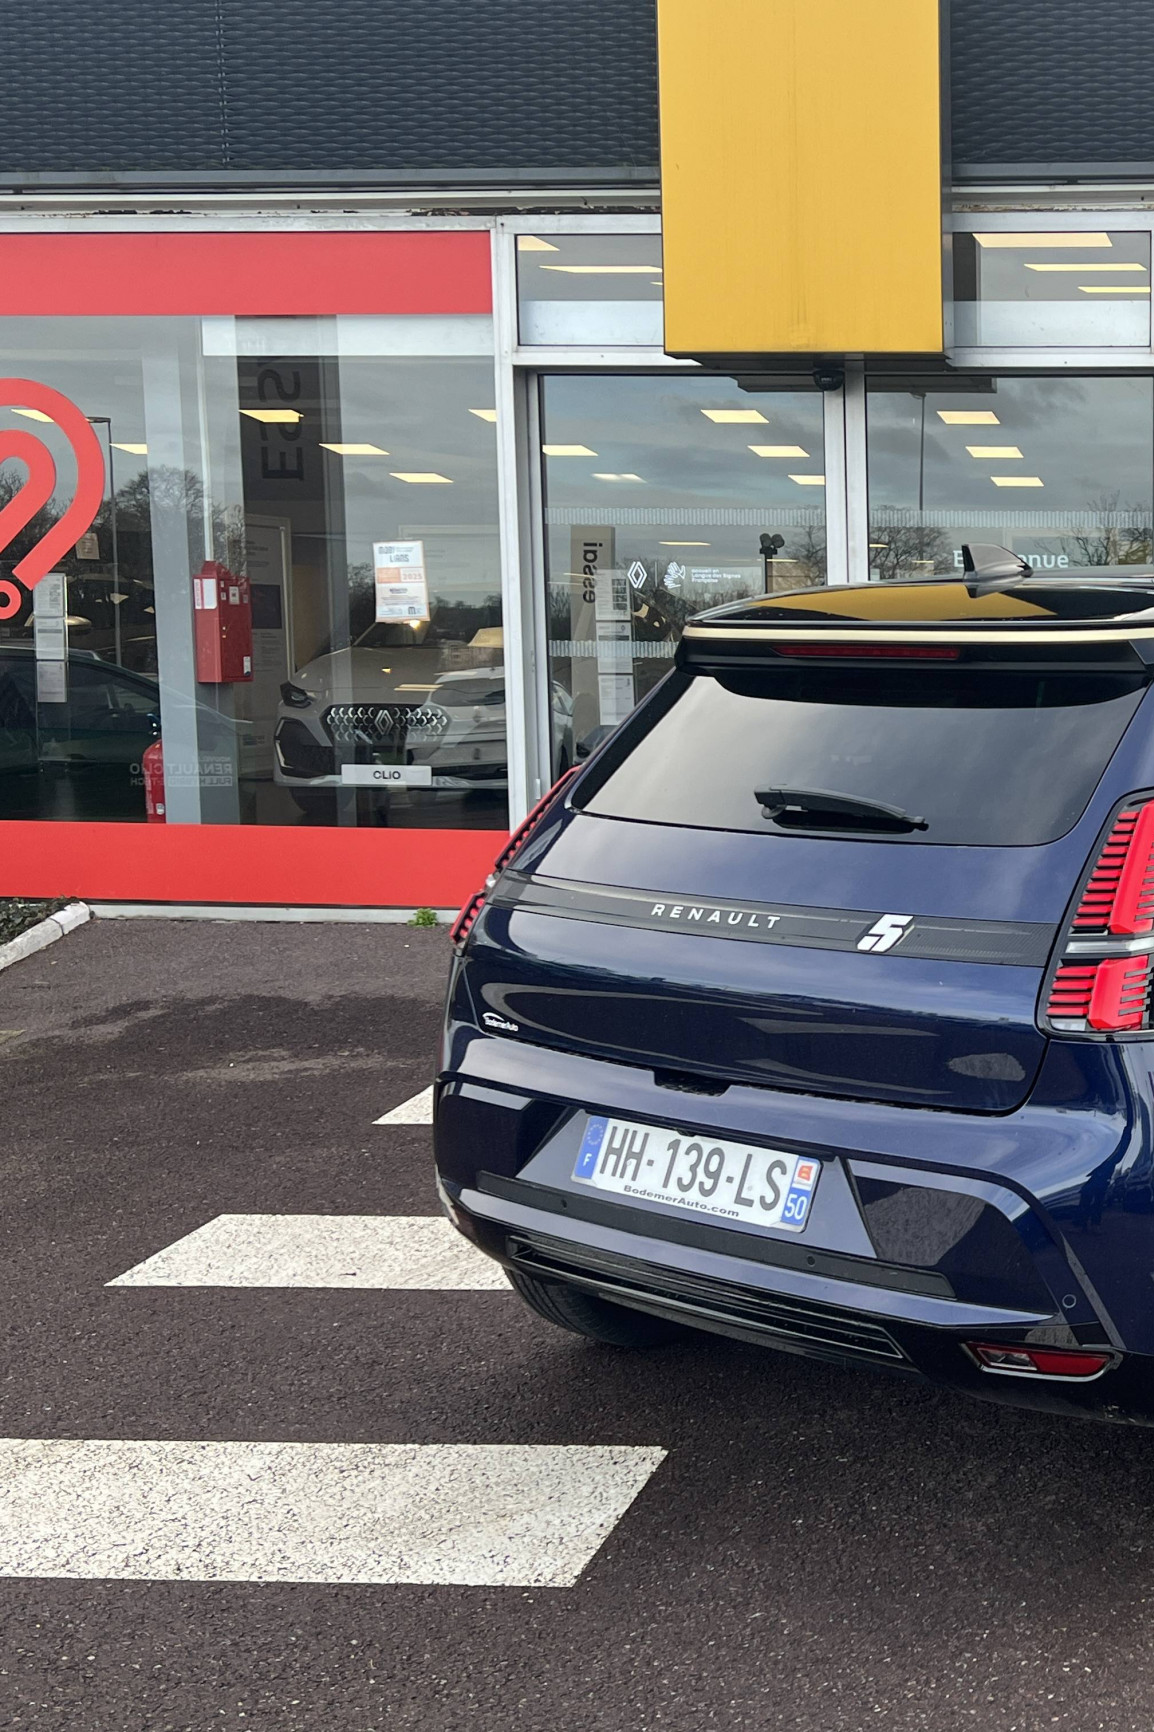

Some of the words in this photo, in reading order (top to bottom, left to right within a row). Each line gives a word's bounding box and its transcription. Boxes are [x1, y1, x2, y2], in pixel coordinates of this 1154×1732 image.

[372, 770, 402, 780] CLIO
[651, 903, 781, 929] RENAULT
[856, 913, 915, 953] 5
[582, 1152, 592, 1167] F
[600, 1125, 788, 1212] HH-139-LS
[623, 1184, 740, 1218] BodemerAuto.com
[784, 1193, 808, 1220] 50
